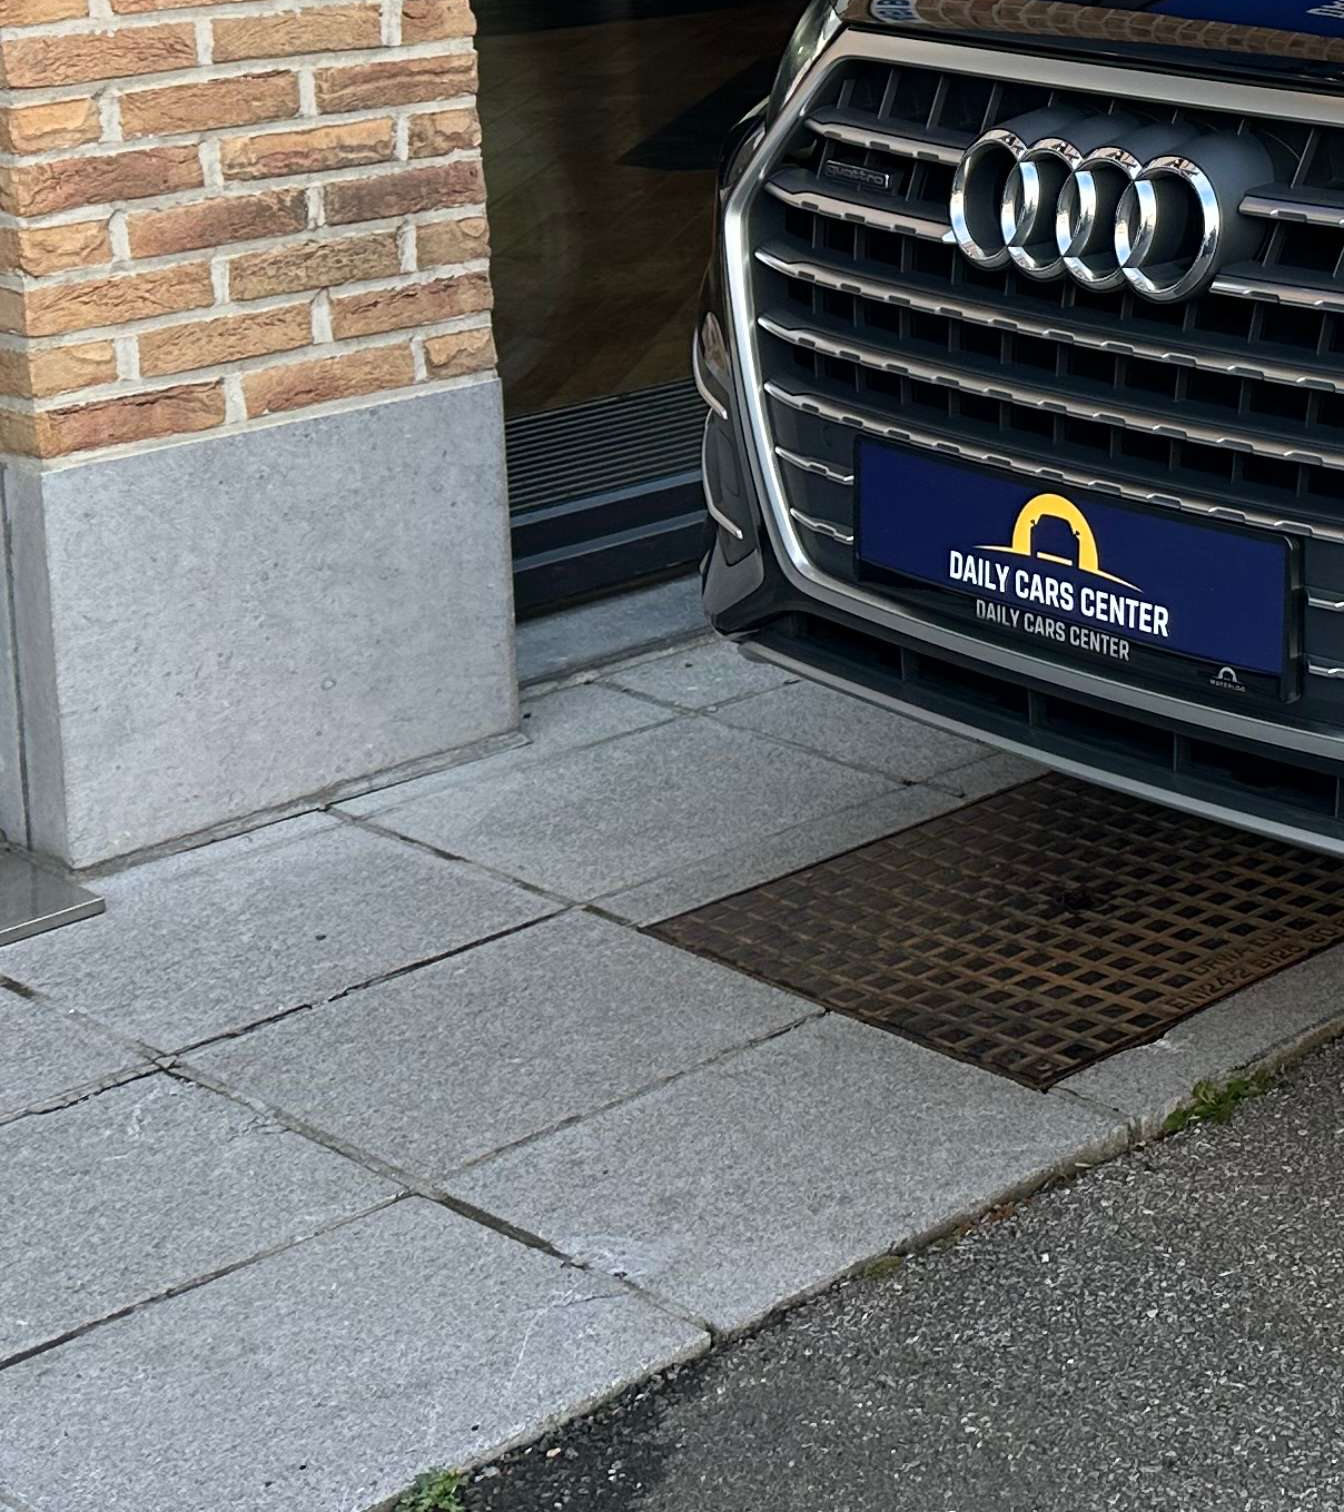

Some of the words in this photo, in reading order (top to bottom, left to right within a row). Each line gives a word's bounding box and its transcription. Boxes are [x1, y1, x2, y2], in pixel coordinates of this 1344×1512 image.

[949, 550, 1009, 594] DAILY
[1015, 569, 1074, 612] CARS
[1080, 586, 1169, 638] CENTER
[975, 599, 1020, 629] DAILY
[1024, 613, 1066, 643] CARS
[1069, 625, 1130, 662] CENTER
